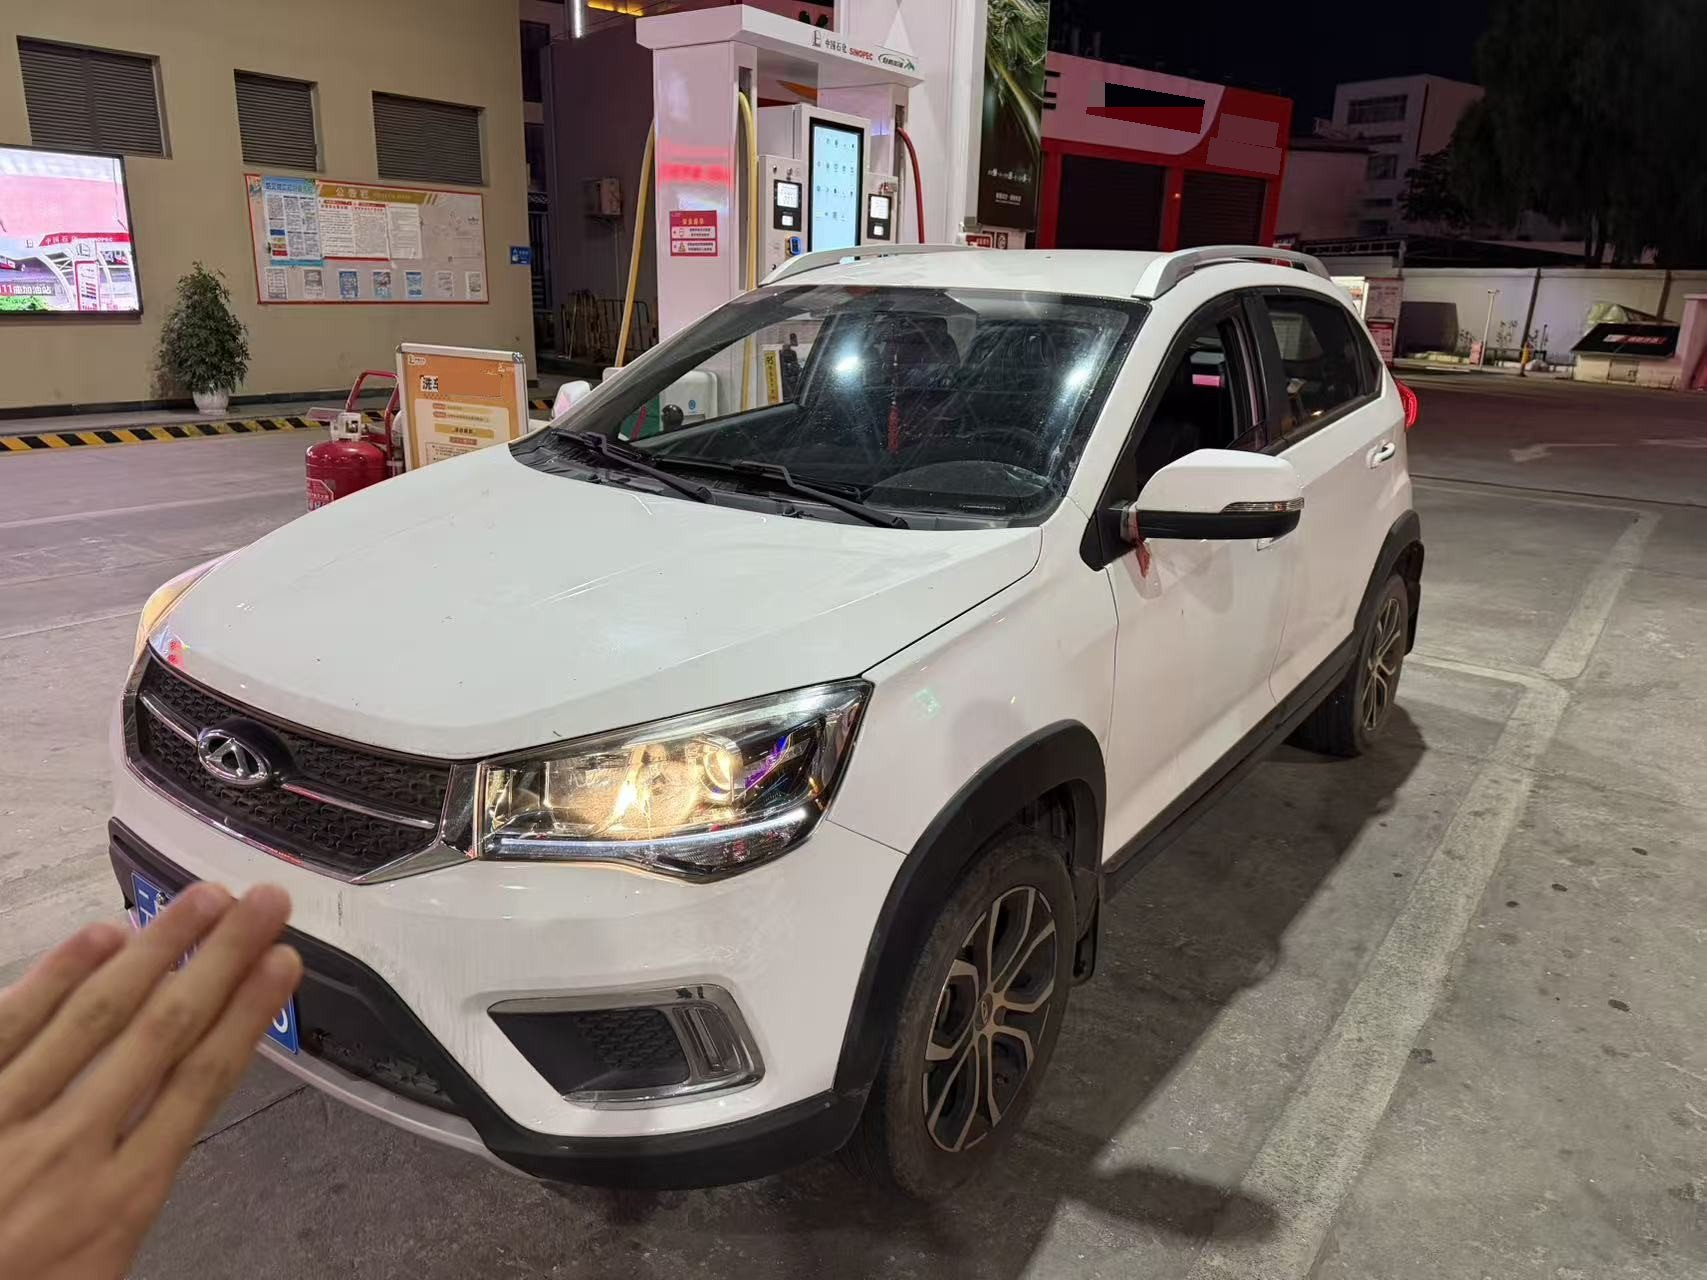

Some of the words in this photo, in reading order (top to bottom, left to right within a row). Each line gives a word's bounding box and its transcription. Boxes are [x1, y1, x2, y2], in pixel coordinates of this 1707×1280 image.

[825, 39, 847, 53] 中国石化
[849, 47, 873, 60] SINOPEC
